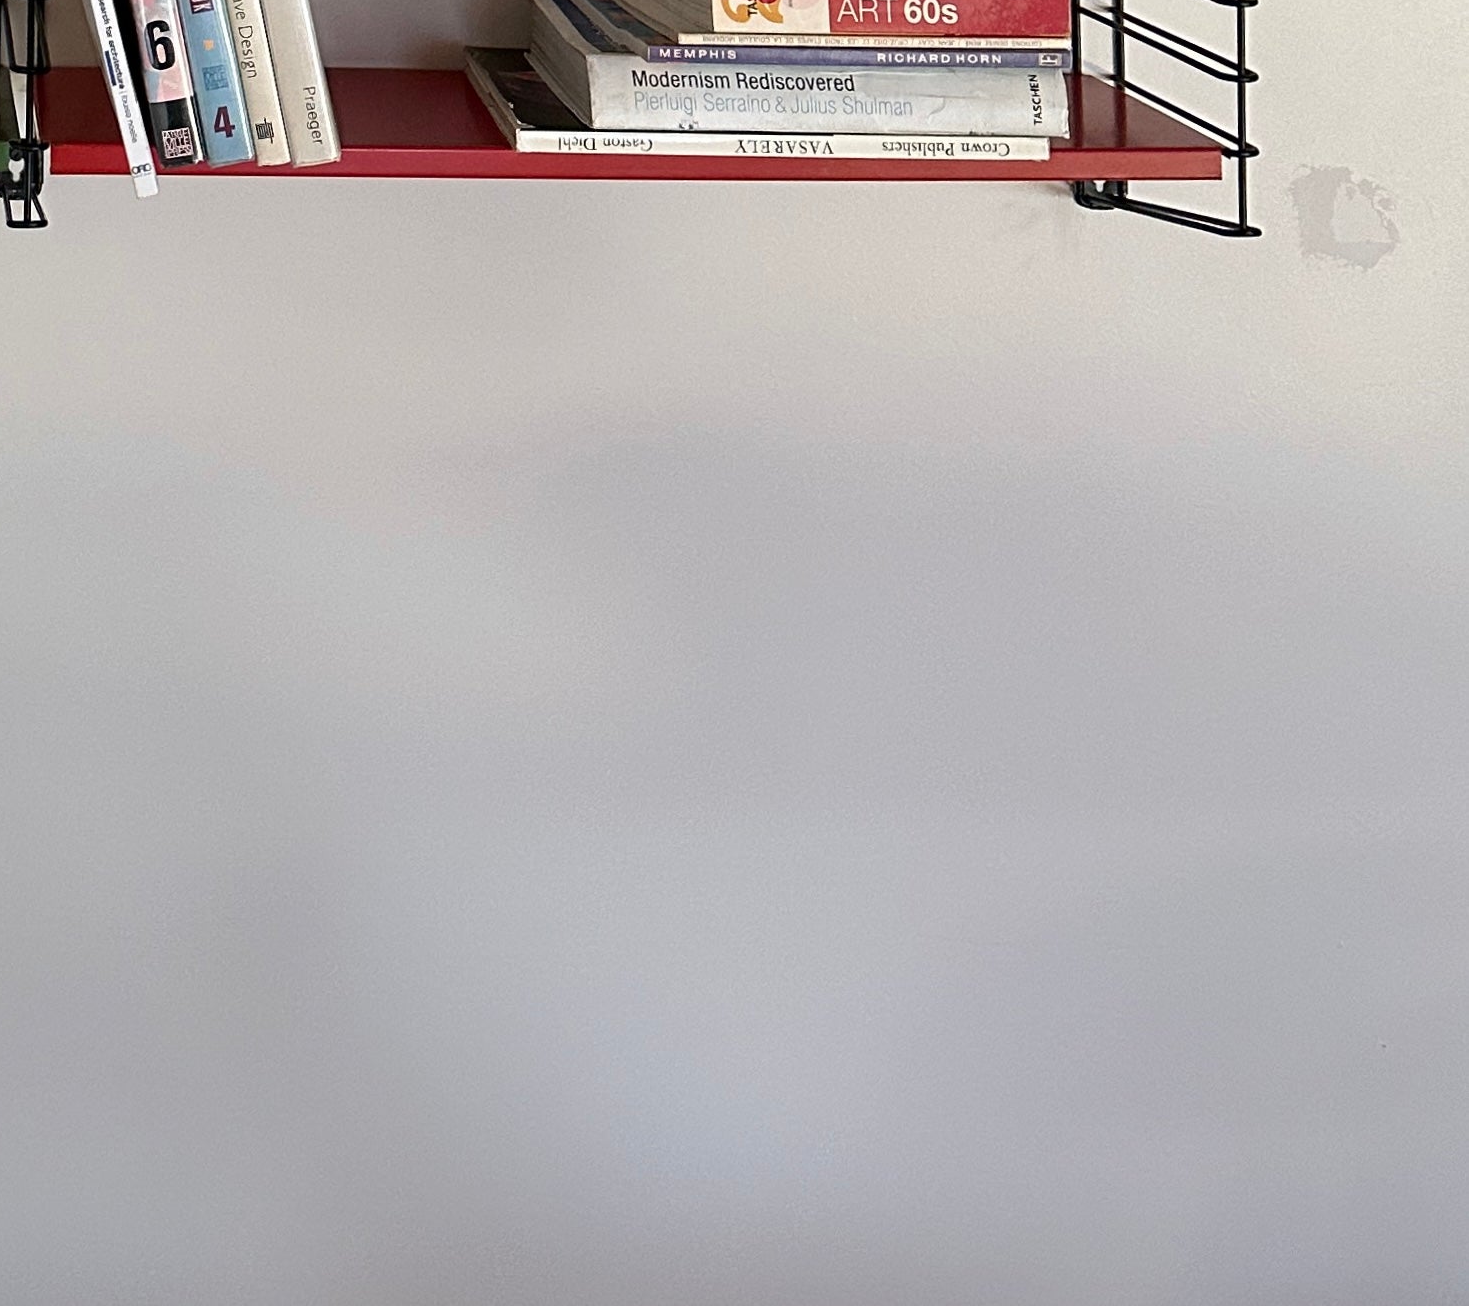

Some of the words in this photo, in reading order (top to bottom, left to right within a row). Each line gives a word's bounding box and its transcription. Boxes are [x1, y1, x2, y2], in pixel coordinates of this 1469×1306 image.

[105, 26, 114, 38] for
[145, 19, 176, 71] 6
[238, 25, 258, 79] Design
[659, 47, 737, 61] MEMPHIS
[876, 52, 951, 65] RICHARD
[955, 53, 1003, 66] HORN
[108, 40, 126, 90] architecture
[631, 69, 730, 89] Modernism
[736, 72, 855, 92] Rediscovered
[633, 91, 698, 117] Pierluigi
[703, 93, 770, 114] Serraino
[775, 95, 787, 113] &
[790, 94, 836, 115] Julius
[837, 95, 914, 116] Shulman
[1028, 74, 1043, 126] TASCHEN
[213, 105, 236, 139] 4
[303, 86, 324, 145] Praeger
[557, 136, 597, 151] Diehl
[602, 137, 653, 151] Gaston
[734, 138, 834, 155] VASARELY
[882, 140, 955, 157] Publishers
[960, 141, 1010, 157] Crown
